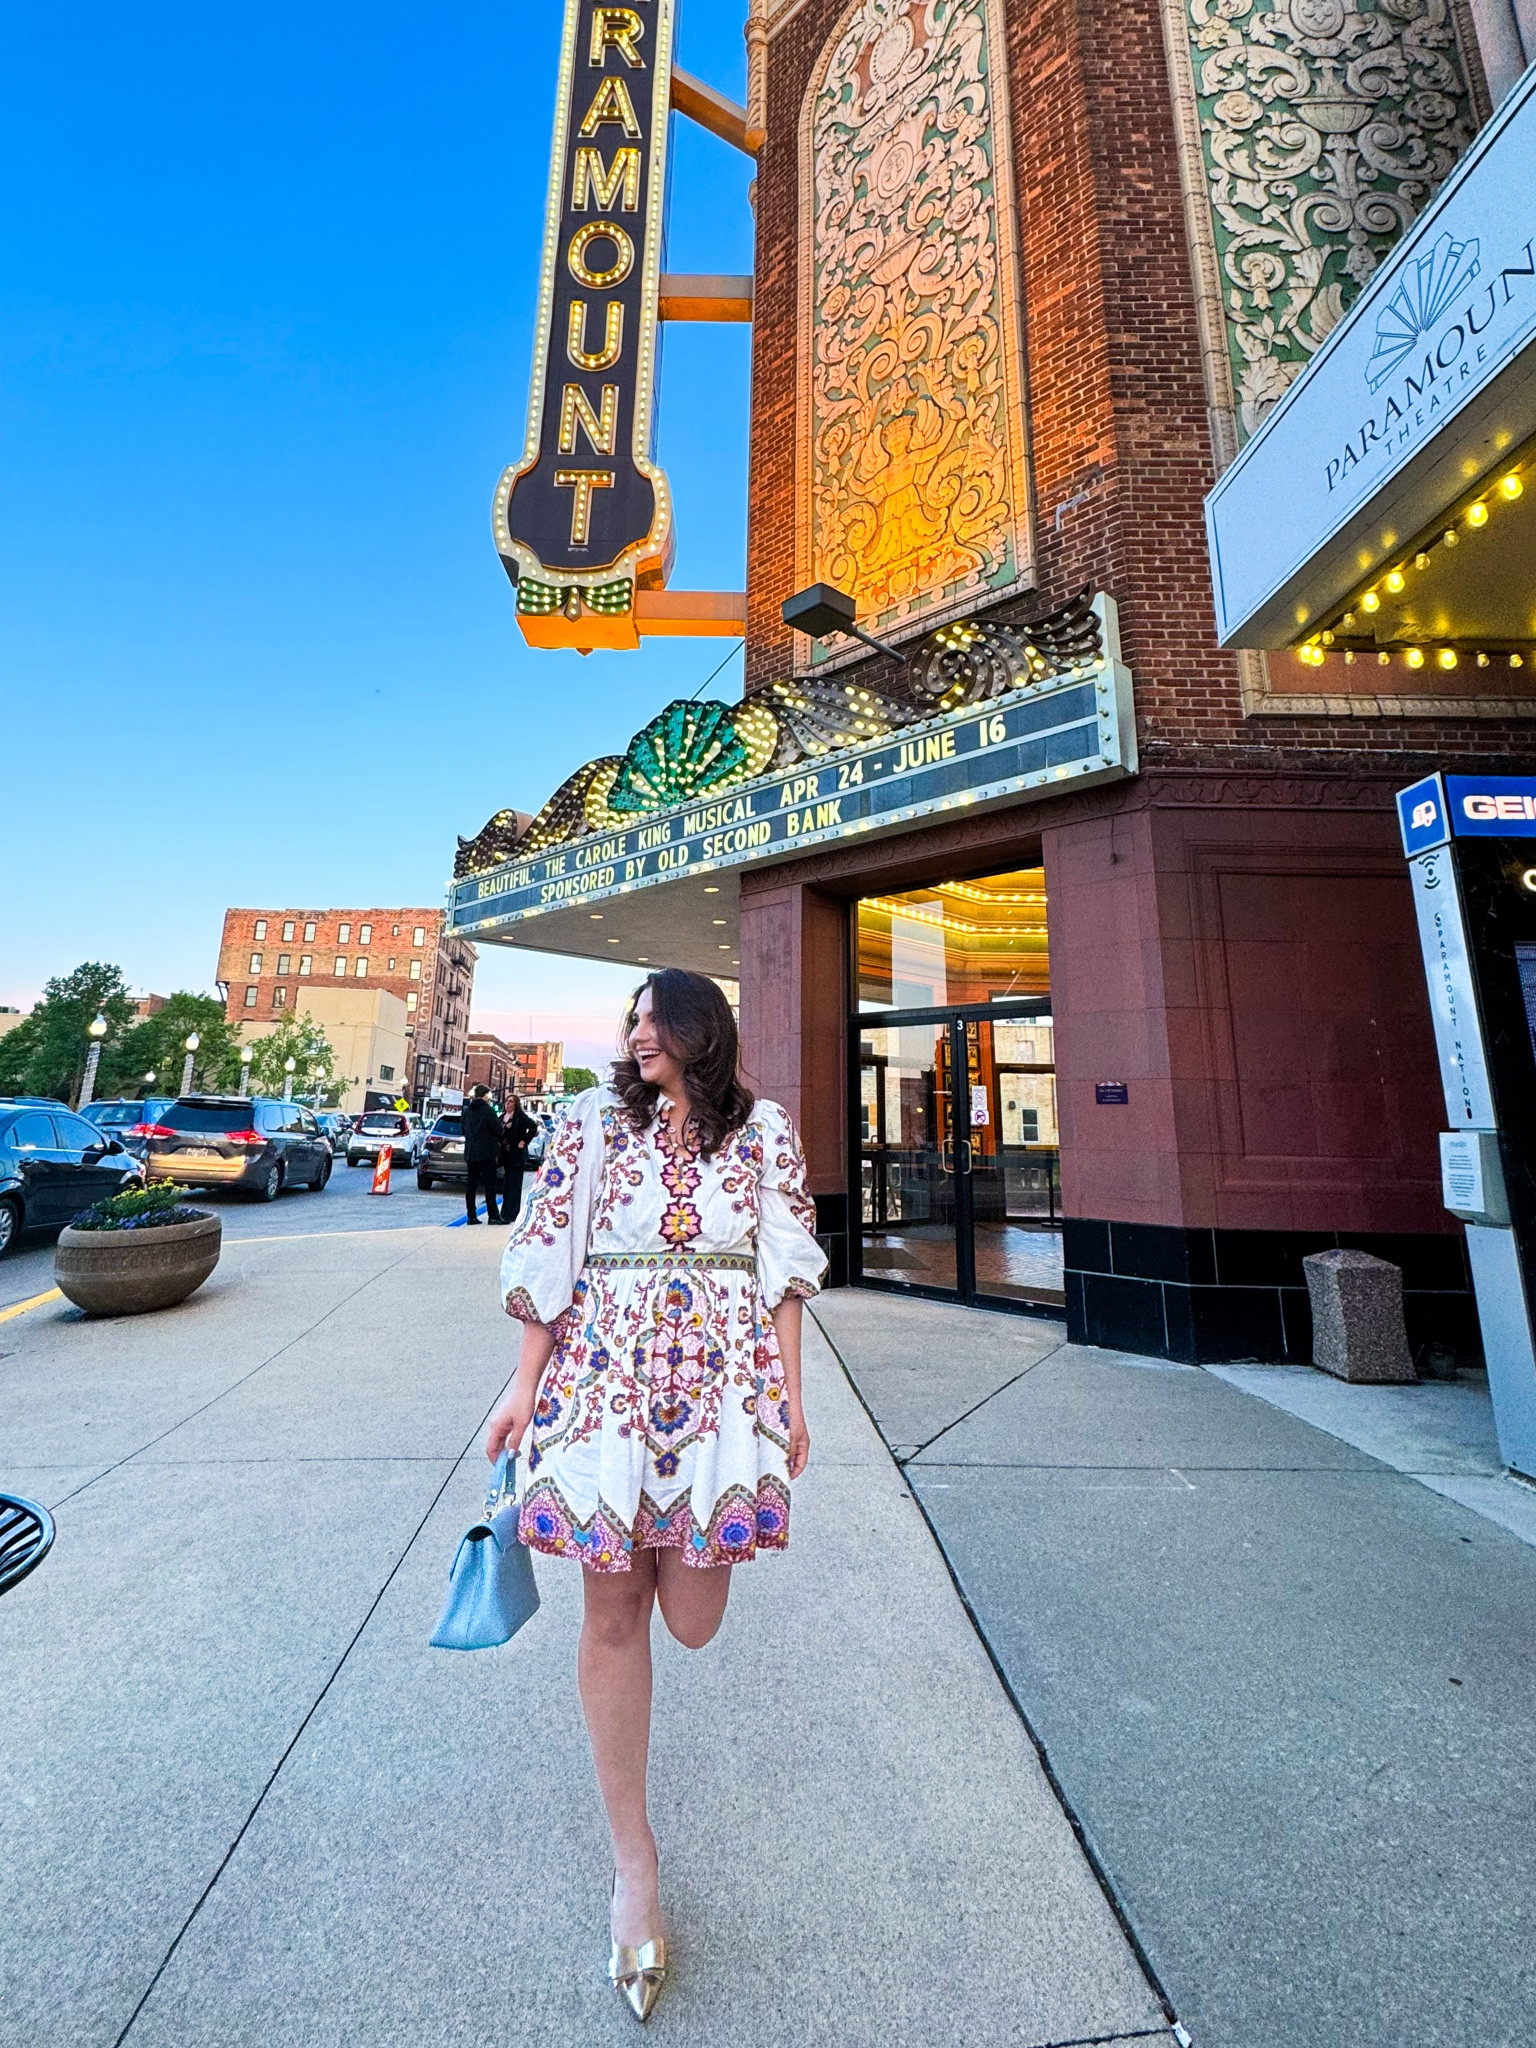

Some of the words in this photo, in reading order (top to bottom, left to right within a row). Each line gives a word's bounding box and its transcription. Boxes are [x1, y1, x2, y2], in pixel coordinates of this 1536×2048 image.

[553, 0, 647, 546] RAMOUNT
[1324, 237, 1535, 494] PARAMOUN
[1384, 344, 1487, 455] THEATRE
[477, 865, 537, 899] BEAUTIFUL:
[545, 858, 566, 878] THE
[576, 836, 626, 869] CAROLE
[638, 821, 671, 850] KING
[683, 796, 756, 837] MUSICAL
[780, 775, 819, 807] APR
[838, 761, 864, 790] 24
[893, 731, 956, 774] JUNE
[979, 714, 1006, 747] 16
[540, 867, 615, 904] SPONSORED
[625, 858, 646, 879] BY
[658, 845, 689, 871] OLD
[703, 820, 771, 860] SECOND
[786, 799, 842, 837] BANK
[1462, 794, 1536, 820] GEI
[956, 1020, 964, 1031] 3
[1437, 929, 1456, 1027] PARAMOUNT
[1455, 1041, 1471, 1108] NATION
